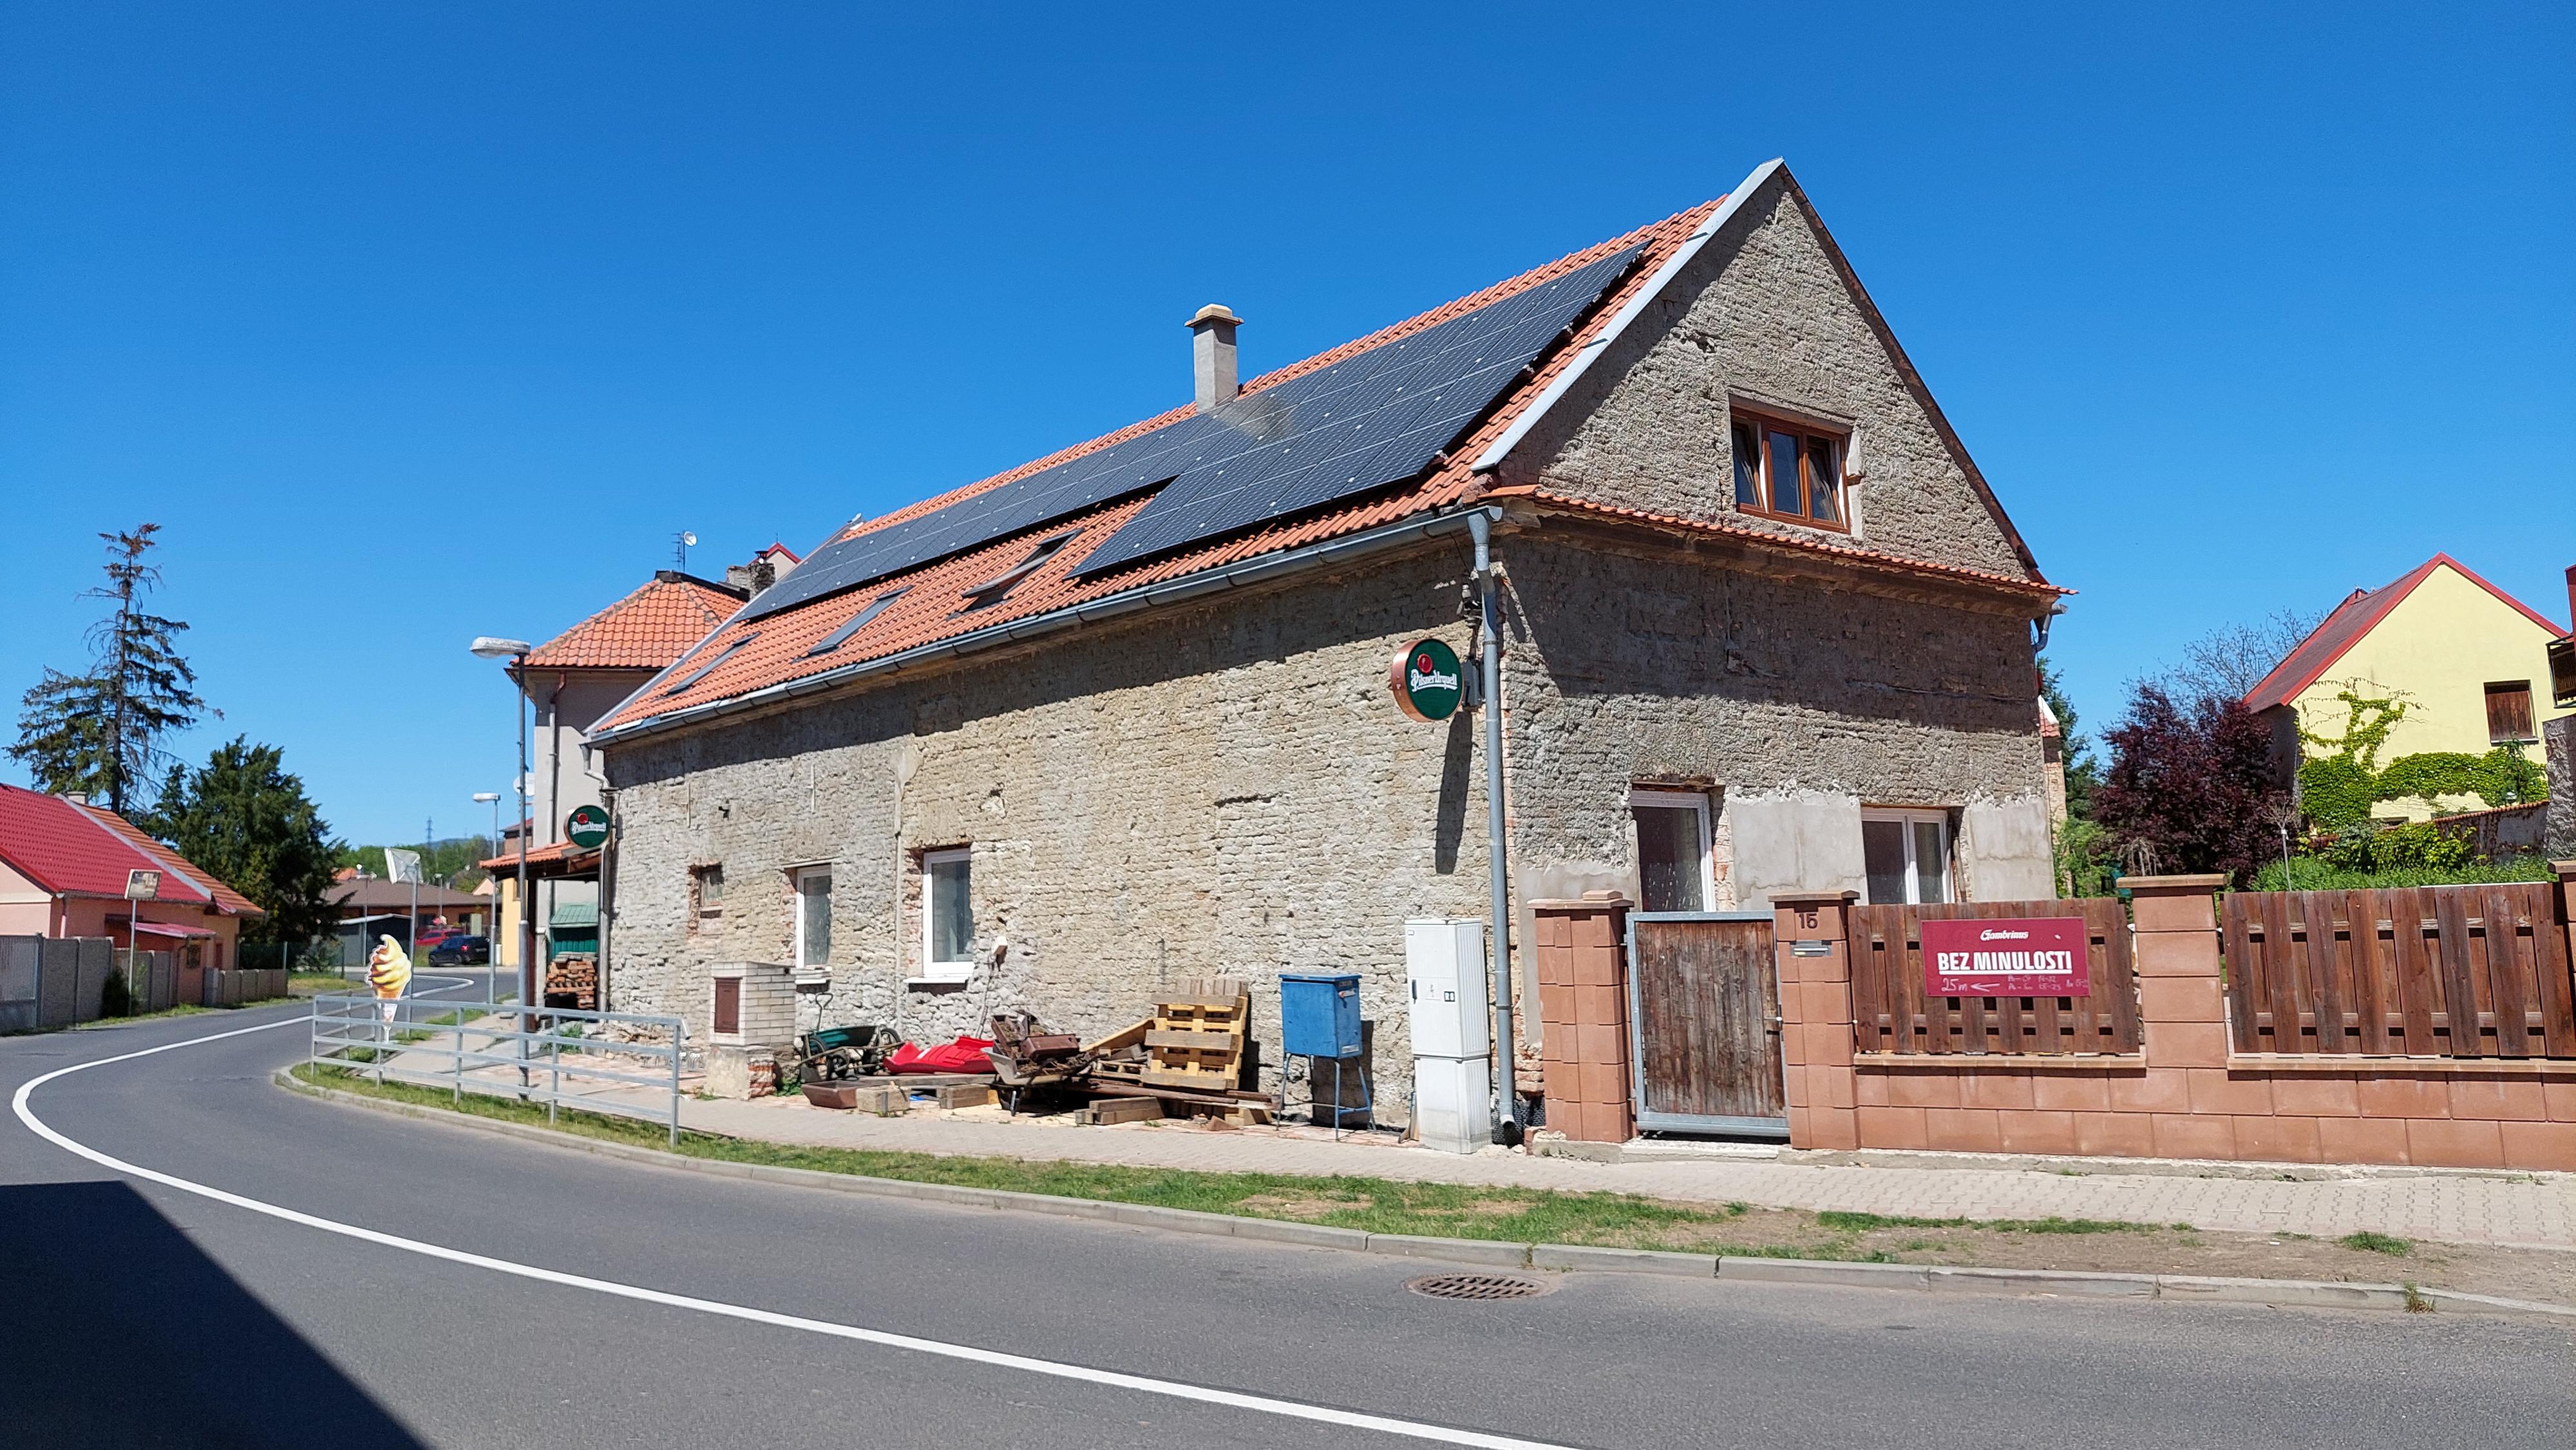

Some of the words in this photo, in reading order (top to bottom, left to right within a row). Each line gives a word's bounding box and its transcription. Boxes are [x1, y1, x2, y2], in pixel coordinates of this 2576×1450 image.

[1410, 669, 1434, 692] Pilsner
[1433, 670, 1457, 690] Urquell
[1798, 912, 1818, 928] 15
[1980, 928, 2029, 941] Gambrinus
[1937, 952, 1971, 970] BEZ
[1973, 950, 2072, 970] MINULOSTI
